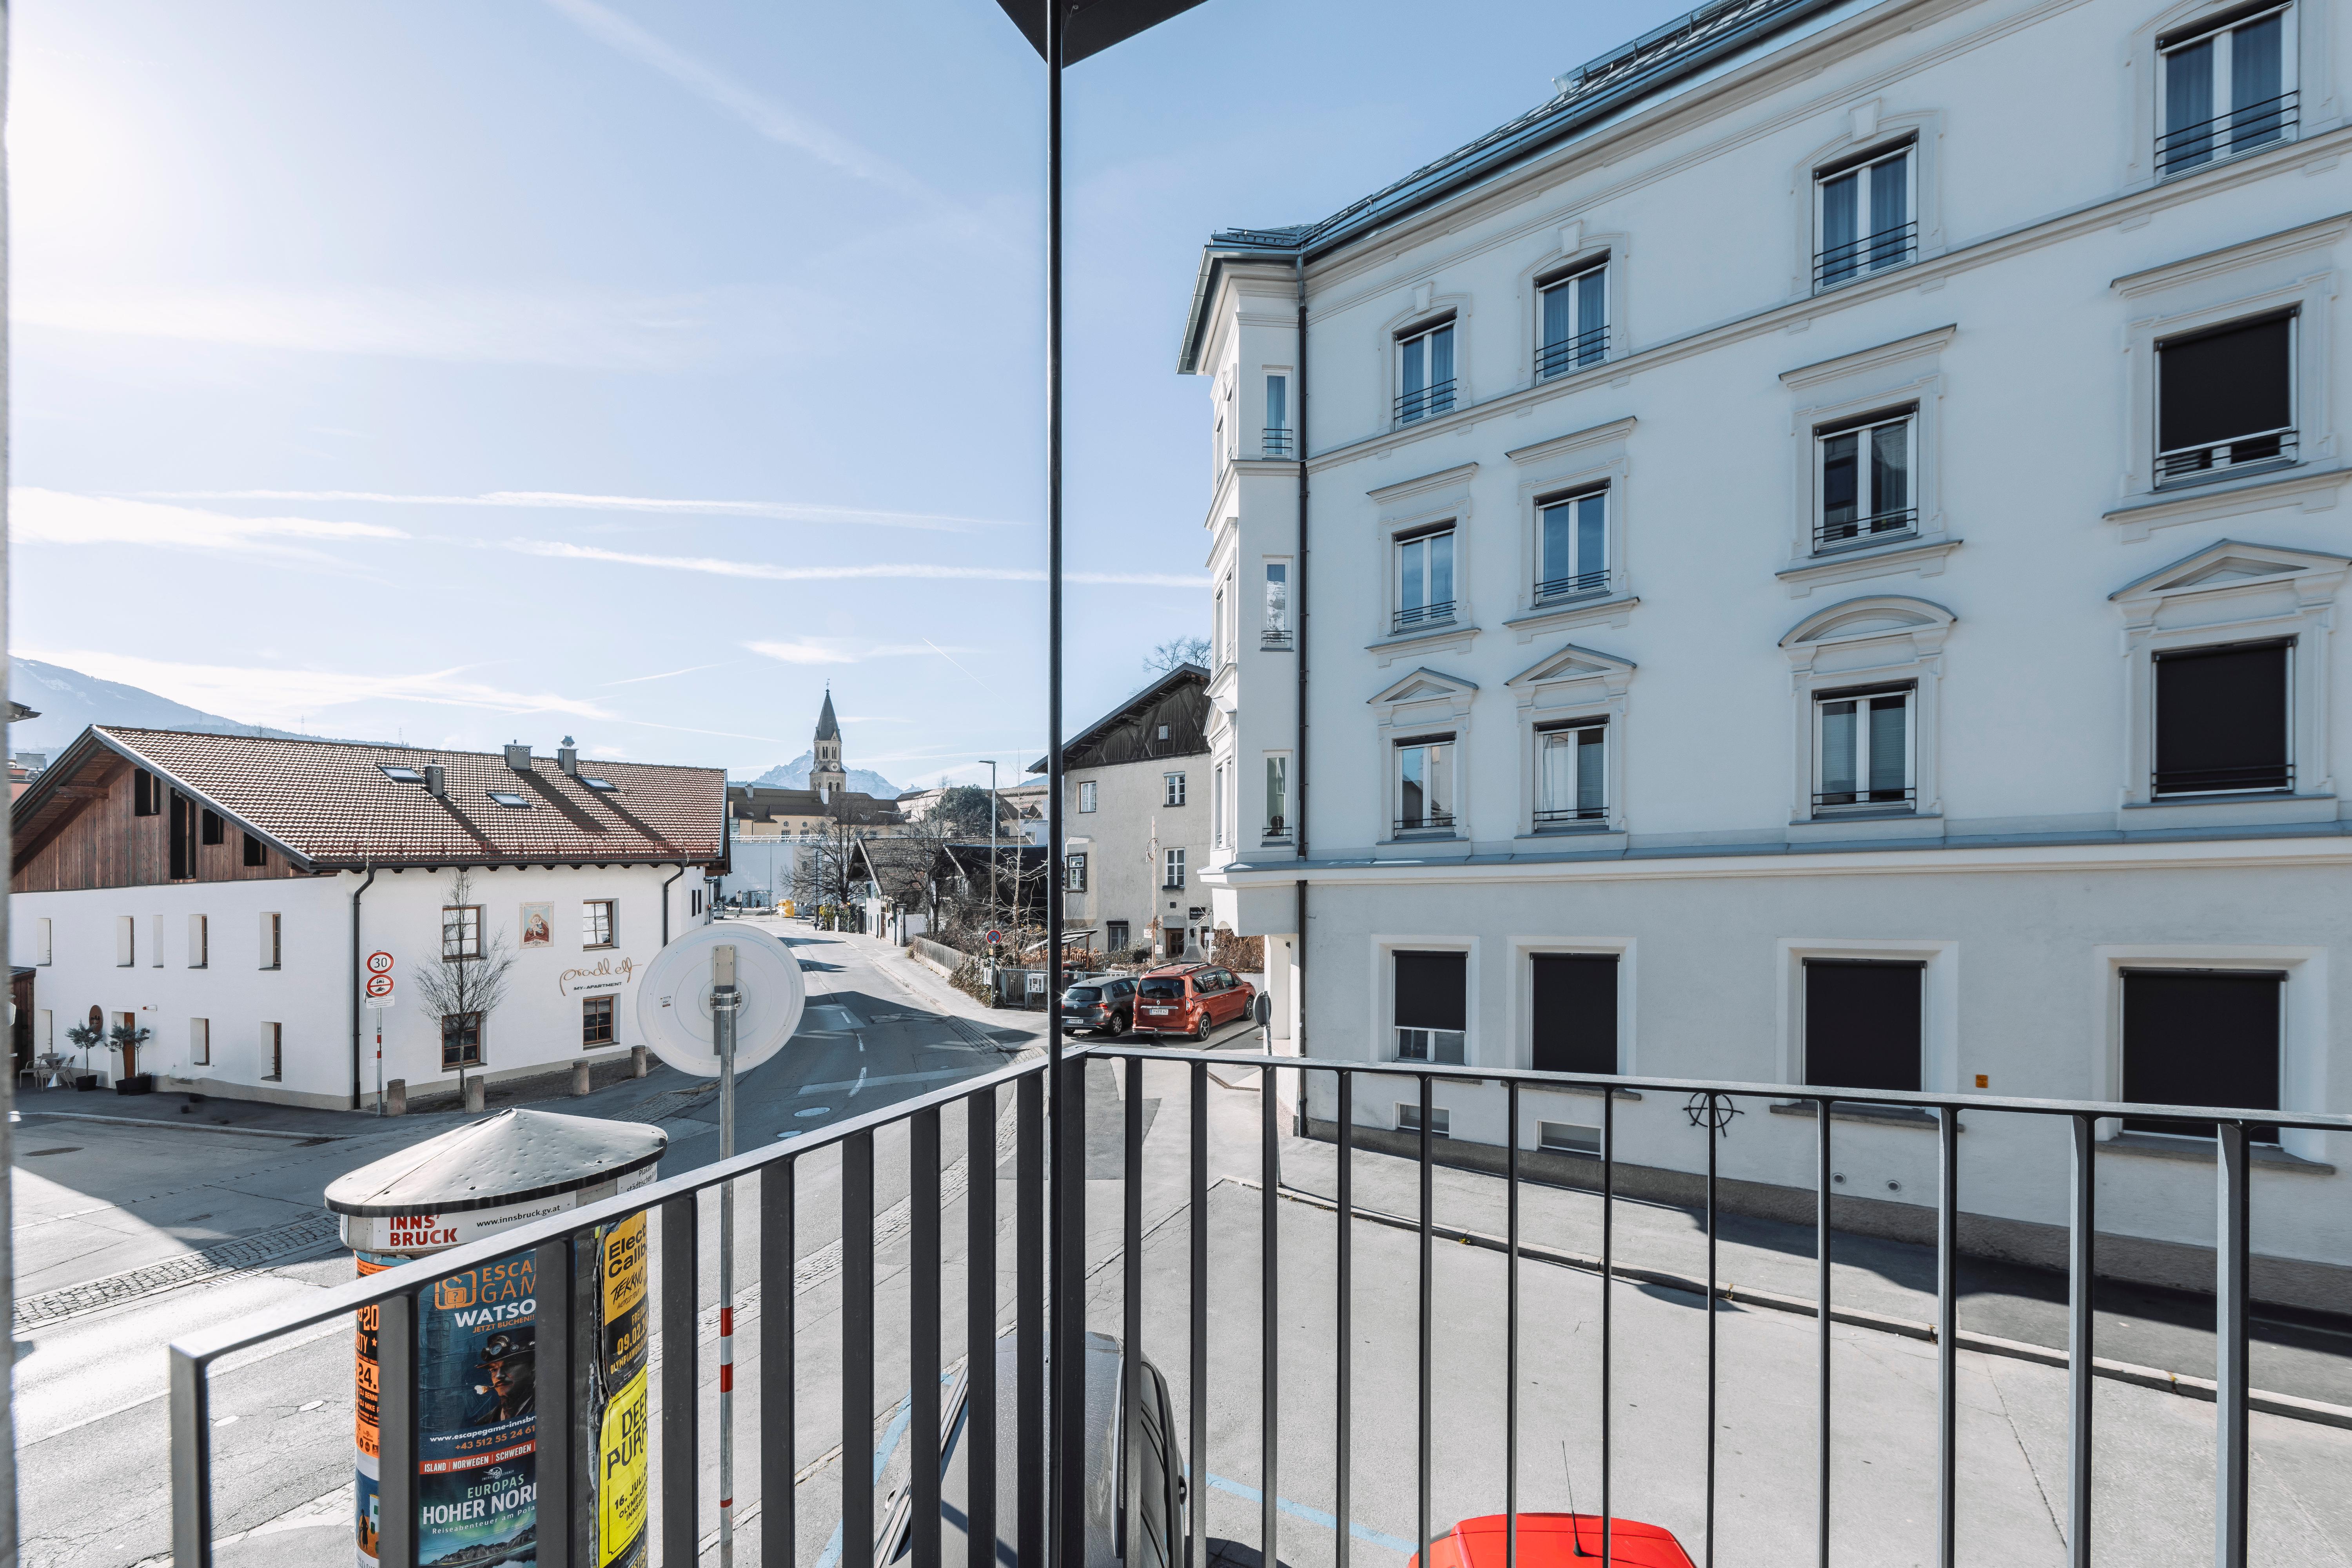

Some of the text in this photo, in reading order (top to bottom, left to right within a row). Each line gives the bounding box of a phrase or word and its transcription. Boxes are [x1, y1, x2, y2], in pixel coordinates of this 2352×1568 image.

[374, 957, 387, 968] 30
[560, 958, 613, 996] pradl
[573, 982, 622, 990] MY-APARTMENT
[477, 1205, 560, 1227] www.innsbruck.gv.at
[390, 1228, 458, 1246] BRUCK
[483, 1260, 532, 1282] ESCA
[610, 1266, 643, 1305] TEKKNO
[454, 1299, 536, 1327] WATSO
[617, 1295, 632, 1310] WORLD
[473, 1323, 495, 1333] JETZT
[358, 1362, 377, 1390] 24.
[365, 1402, 375, 1412] MIKE
[456, 1425, 535, 1450] +43 512 55 24 61
[424, 1443, 531, 1472] ISLAND NORWEGEN SCHWEDEN
[467, 1474, 524, 1498] EUROPAS
[615, 1494, 627, 1510] 16.
[630, 1475, 643, 1497] JULI
[423, 1499, 485, 1524] HOHER
[432, 1506, 535, 1534] Reiseabenteuer am Pola
